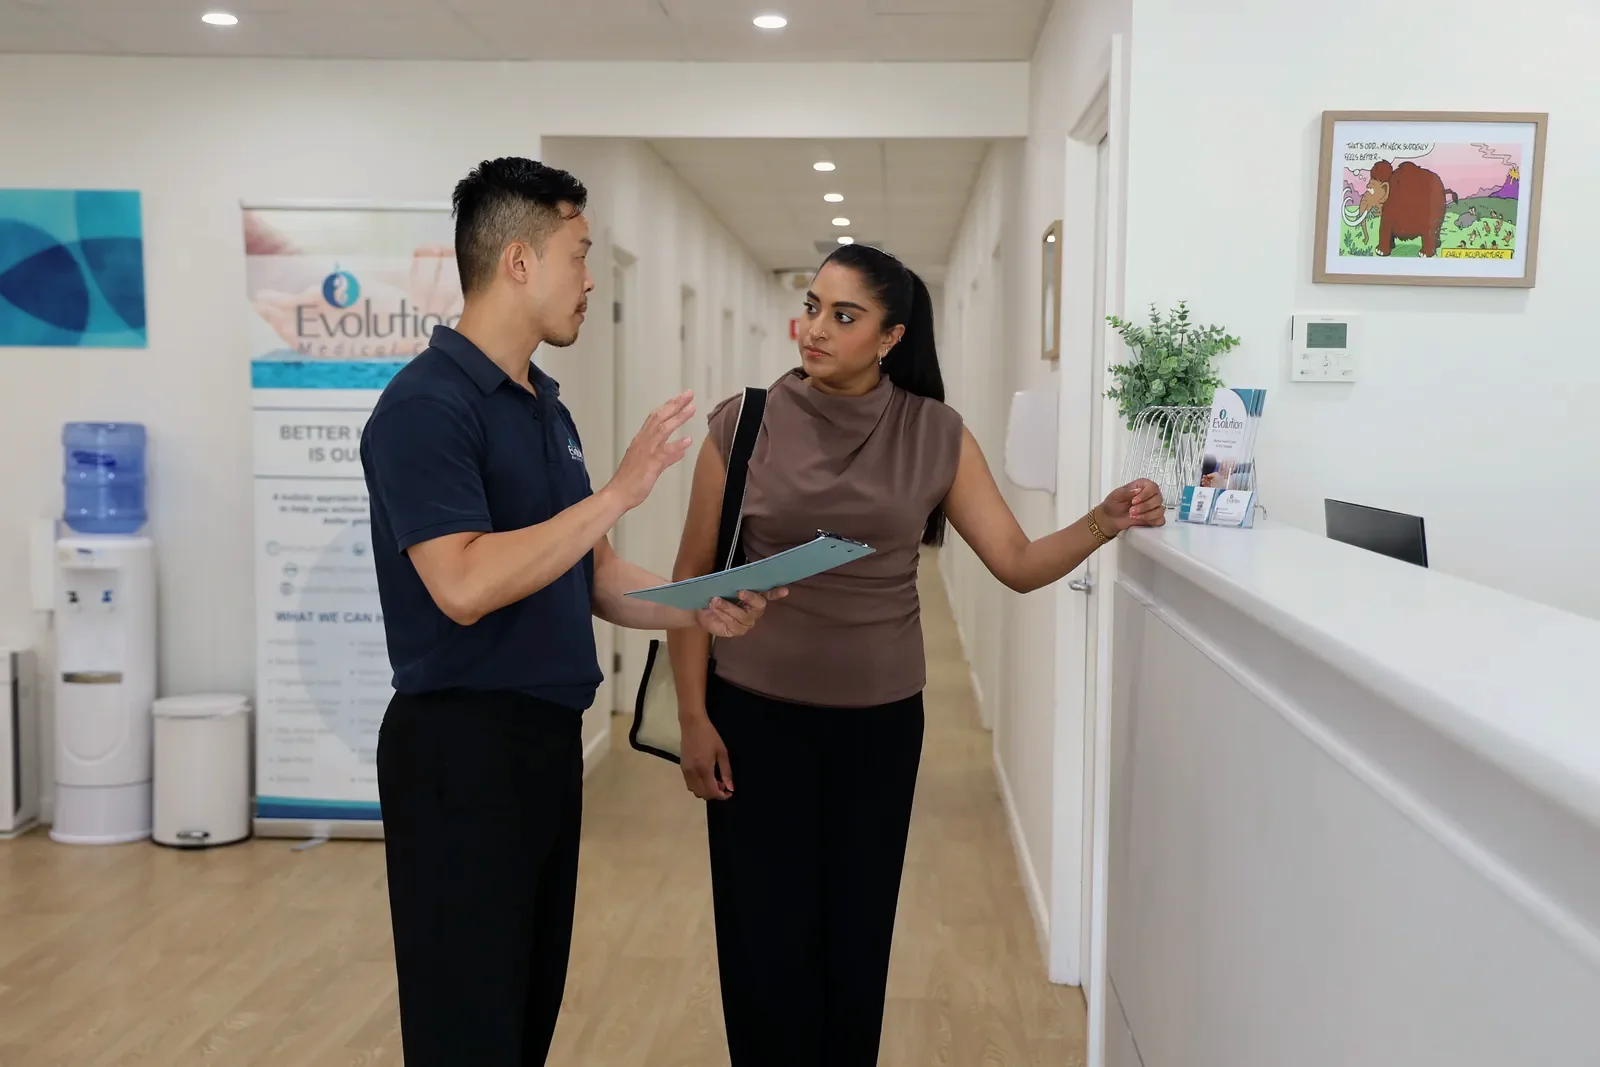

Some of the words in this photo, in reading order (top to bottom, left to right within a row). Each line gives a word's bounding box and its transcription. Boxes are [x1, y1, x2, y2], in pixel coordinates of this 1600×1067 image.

[1388, 142, 1402, 151] NECK
[1403, 142, 1429, 151] SUDDENLY
[1445, 250, 1462, 259] EARLY
[1465, 251, 1504, 259] ACUPUNCTURE
[1212, 416, 1243, 430] Evolution
[280, 424, 351, 441] BETTER
[308, 446, 325, 462] IS
[275, 611, 314, 623] WHAT
[318, 611, 339, 623] WE
[343, 611, 373, 624] CAN
